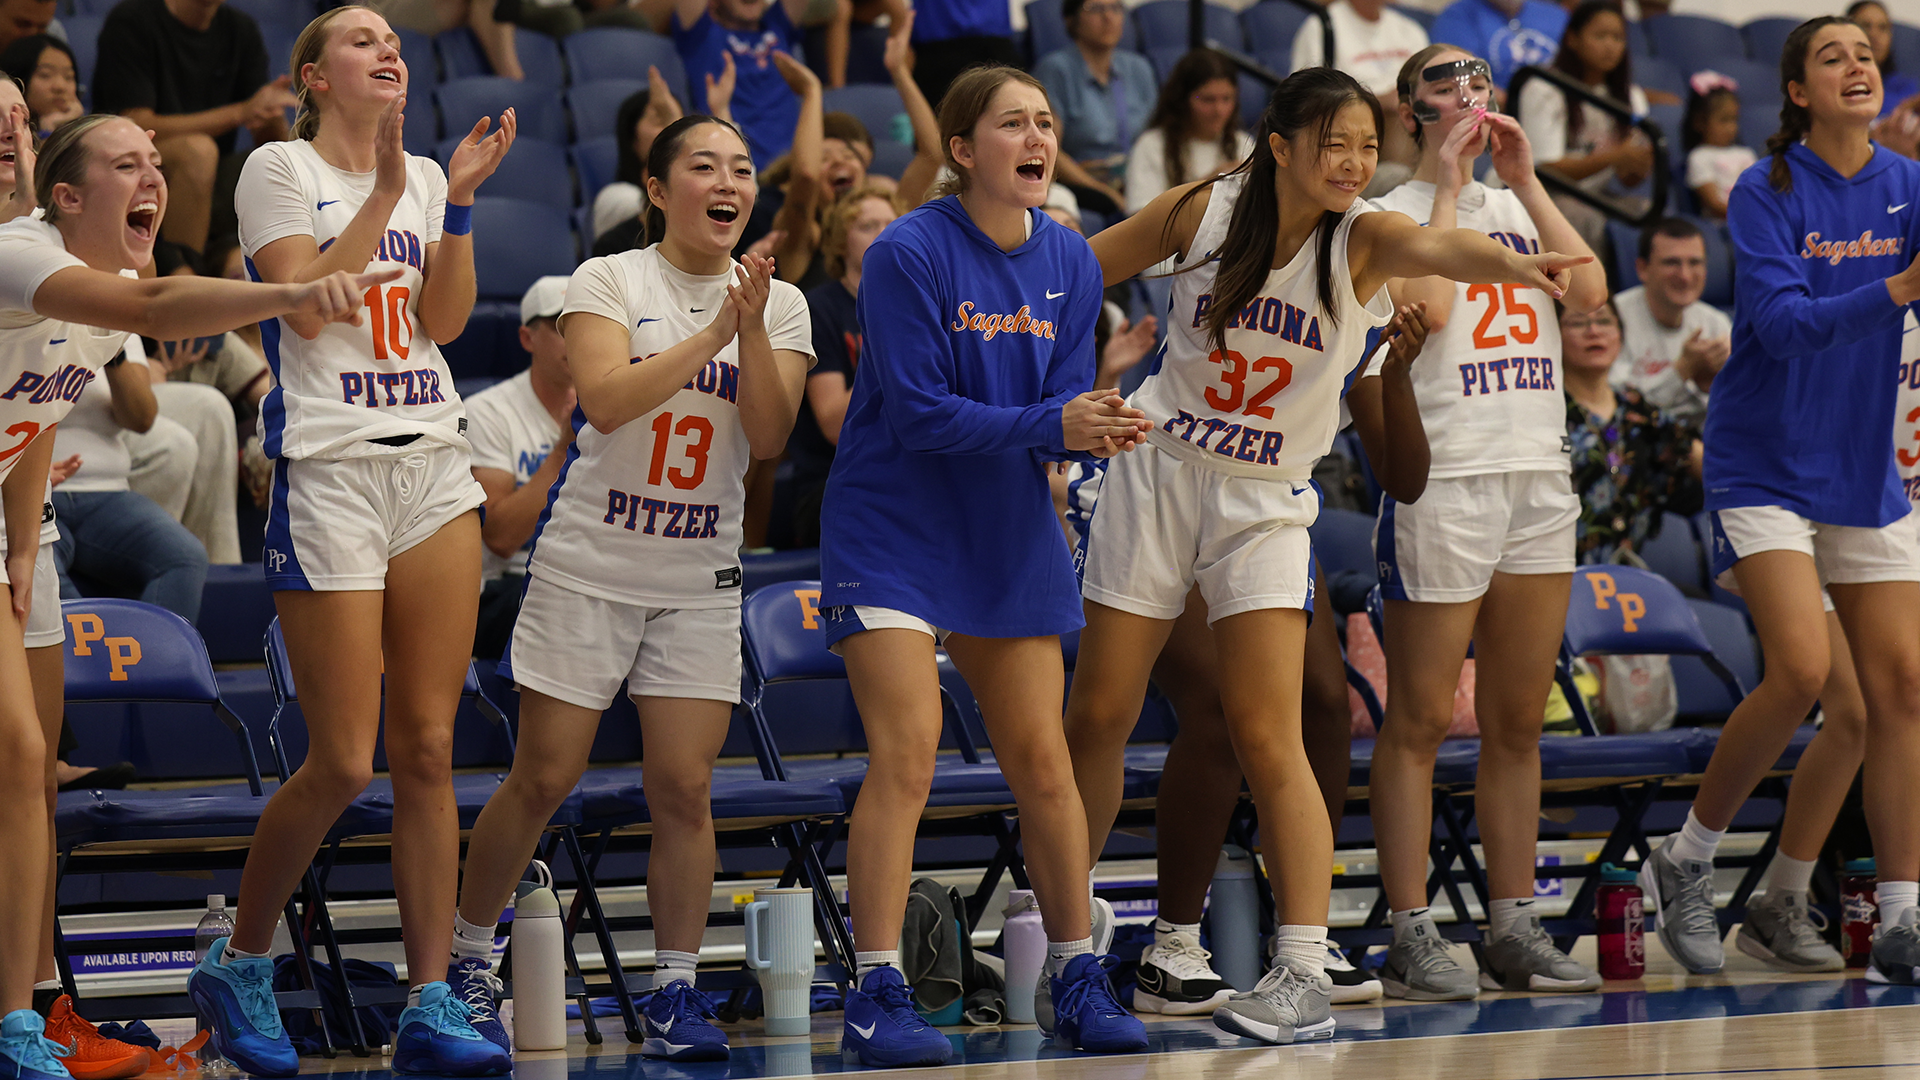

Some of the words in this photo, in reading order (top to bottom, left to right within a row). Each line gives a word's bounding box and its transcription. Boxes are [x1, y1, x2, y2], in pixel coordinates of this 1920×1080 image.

[364, 284, 413, 360] 10
[1192, 294, 1323, 352] PMONA
[1466, 282, 1538, 349] 25
[339, 368, 446, 408] PITZER
[1204, 349, 1293, 420] 32
[1459, 357, 1555, 396] PITZER
[647, 411, 714, 490] 13
[1163, 409, 1284, 466] PITZER
[603, 489, 720, 538] PITZER
[267, 549, 288, 573] PP
[83, 952, 139, 967] AVAILABLE
[141, 951, 170, 964] UPON
